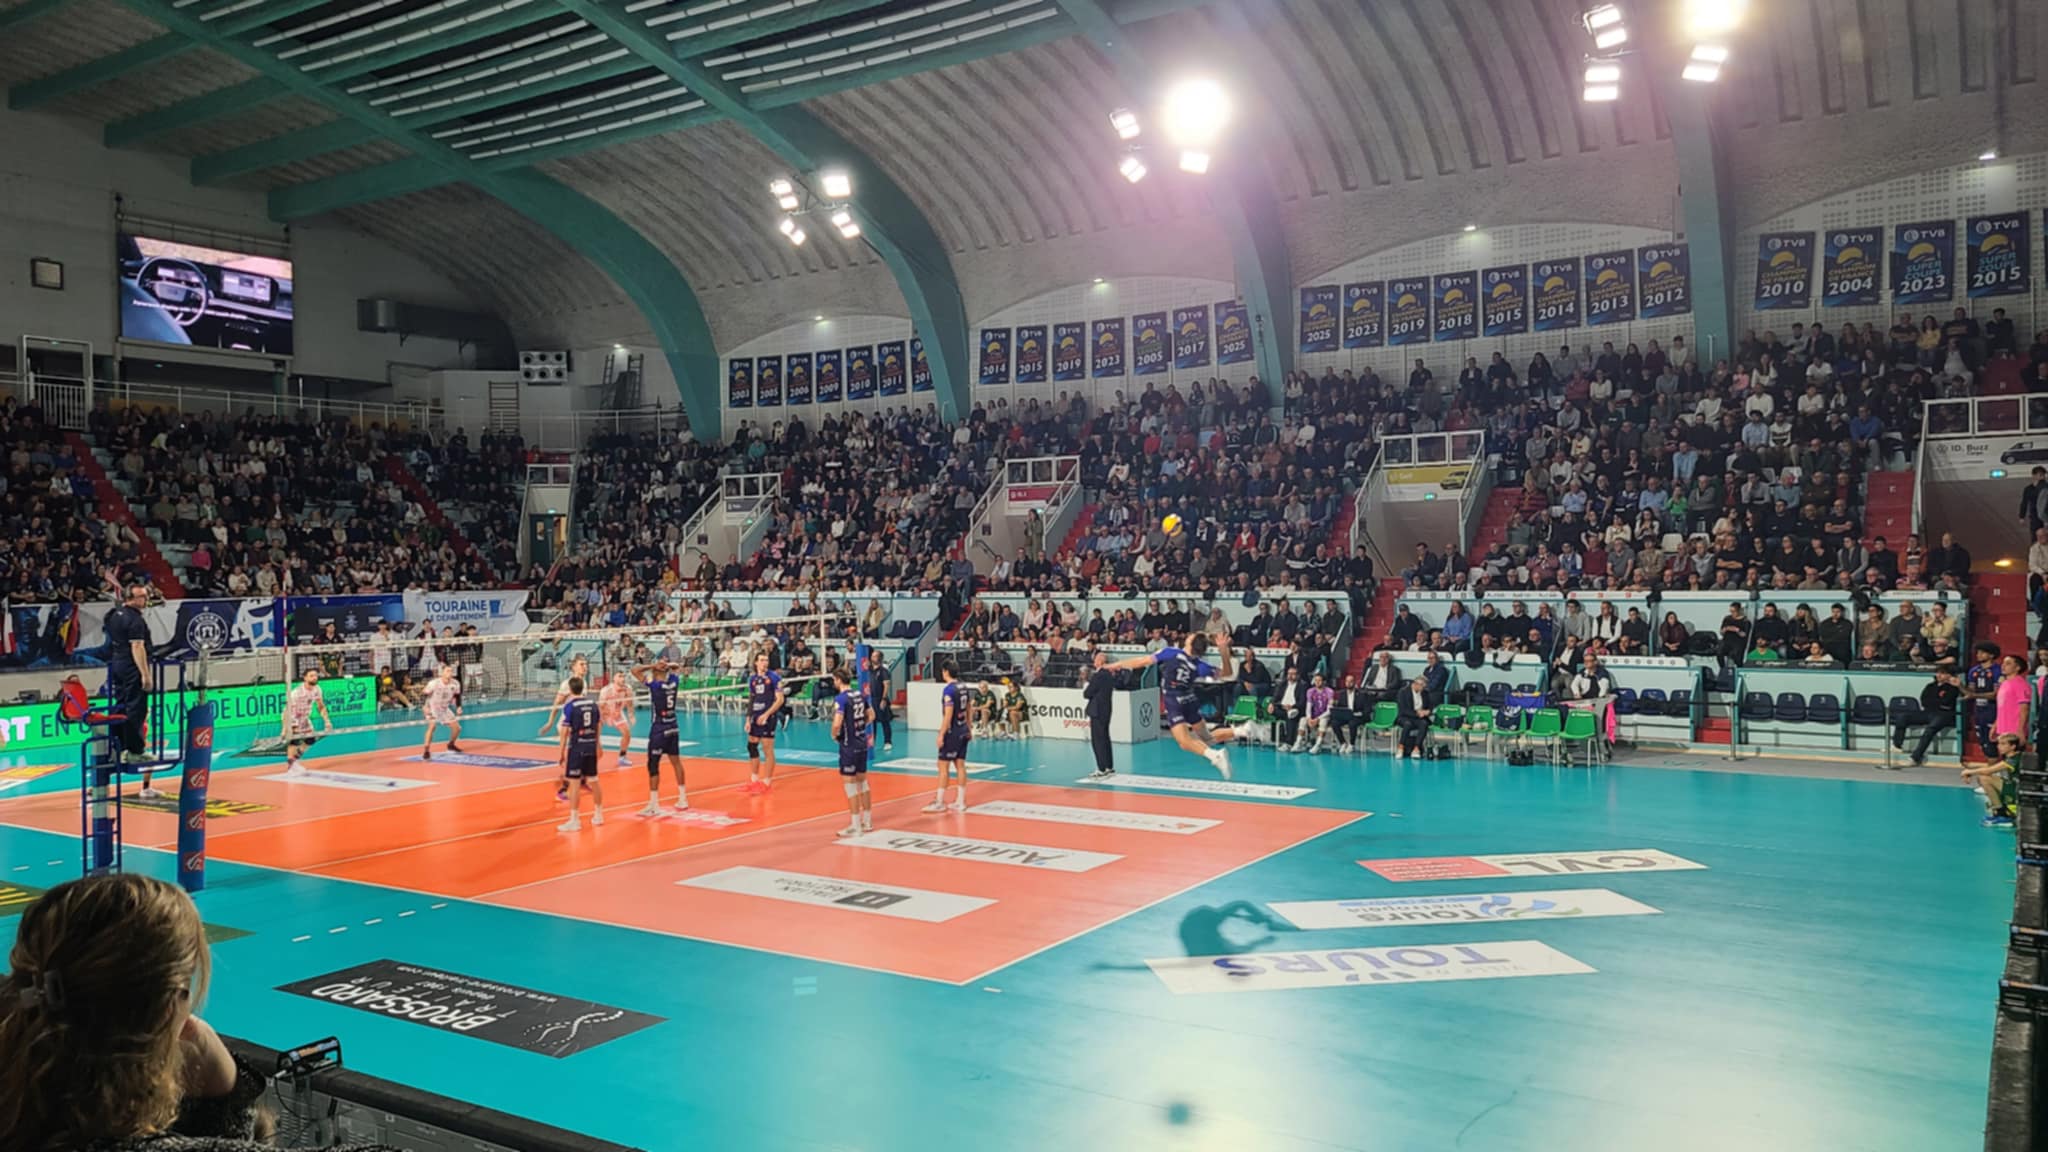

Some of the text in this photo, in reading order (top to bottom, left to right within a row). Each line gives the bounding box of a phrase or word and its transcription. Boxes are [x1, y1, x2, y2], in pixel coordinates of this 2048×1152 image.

[1994, 220, 2019, 230] TVB
[1850, 234, 1874, 243] TVB
[1920, 229, 1945, 239] TVB
[1782, 239, 1806, 248] TVB
[1979, 252, 2016, 265] SUPER
[1906, 261, 1942, 273] SUPER
[1973, 266, 2021, 288] 2015
[1760, 280, 1804, 298] 2010
[1828, 276, 1873, 296] 2004
[1900, 275, 1945, 295] 2023
[1592, 295, 1628, 314] 2013
[1645, 288, 1684, 307] 2012
[1487, 309, 1522, 326] 2015
[1538, 302, 1575, 320] 2014
[1392, 320, 1425, 335] 2019
[1439, 314, 1472, 331] 2018
[1307, 330, 1331, 342] 2025
[1348, 324, 1378, 338] 2023
[1178, 342, 1204, 358] 2017
[1223, 340, 1246, 354] 2025
[1056, 359, 1082, 372] 2019
[1096, 356, 1120, 370] 2023
[1137, 352, 1163, 366] 2005
[982, 362, 1006, 376] 2014
[1018, 361, 1043, 374] 2015
[850, 378, 872, 392] 2010
[882, 376, 903, 388] 2011
[914, 372, 932, 384] 201
[819, 382, 840, 396] 2009
[1966, 444, 1989, 452] Buzz
[424, 600, 487, 612] TOURAINE
[666, 695, 674, 708] 5
[853, 703, 864, 719] 22
[42, 714, 70, 738] EN
[584, 712, 592, 726] 9
[888, 836, 1065, 866] Audilab
[1500, 856, 1657, 874] CVL
[1358, 909, 1485, 922] Tours
[1212, 946, 1511, 978] TOURS
[350, 975, 517, 1019] TRAITEUR
[312, 982, 497, 1030] BROSSARD
